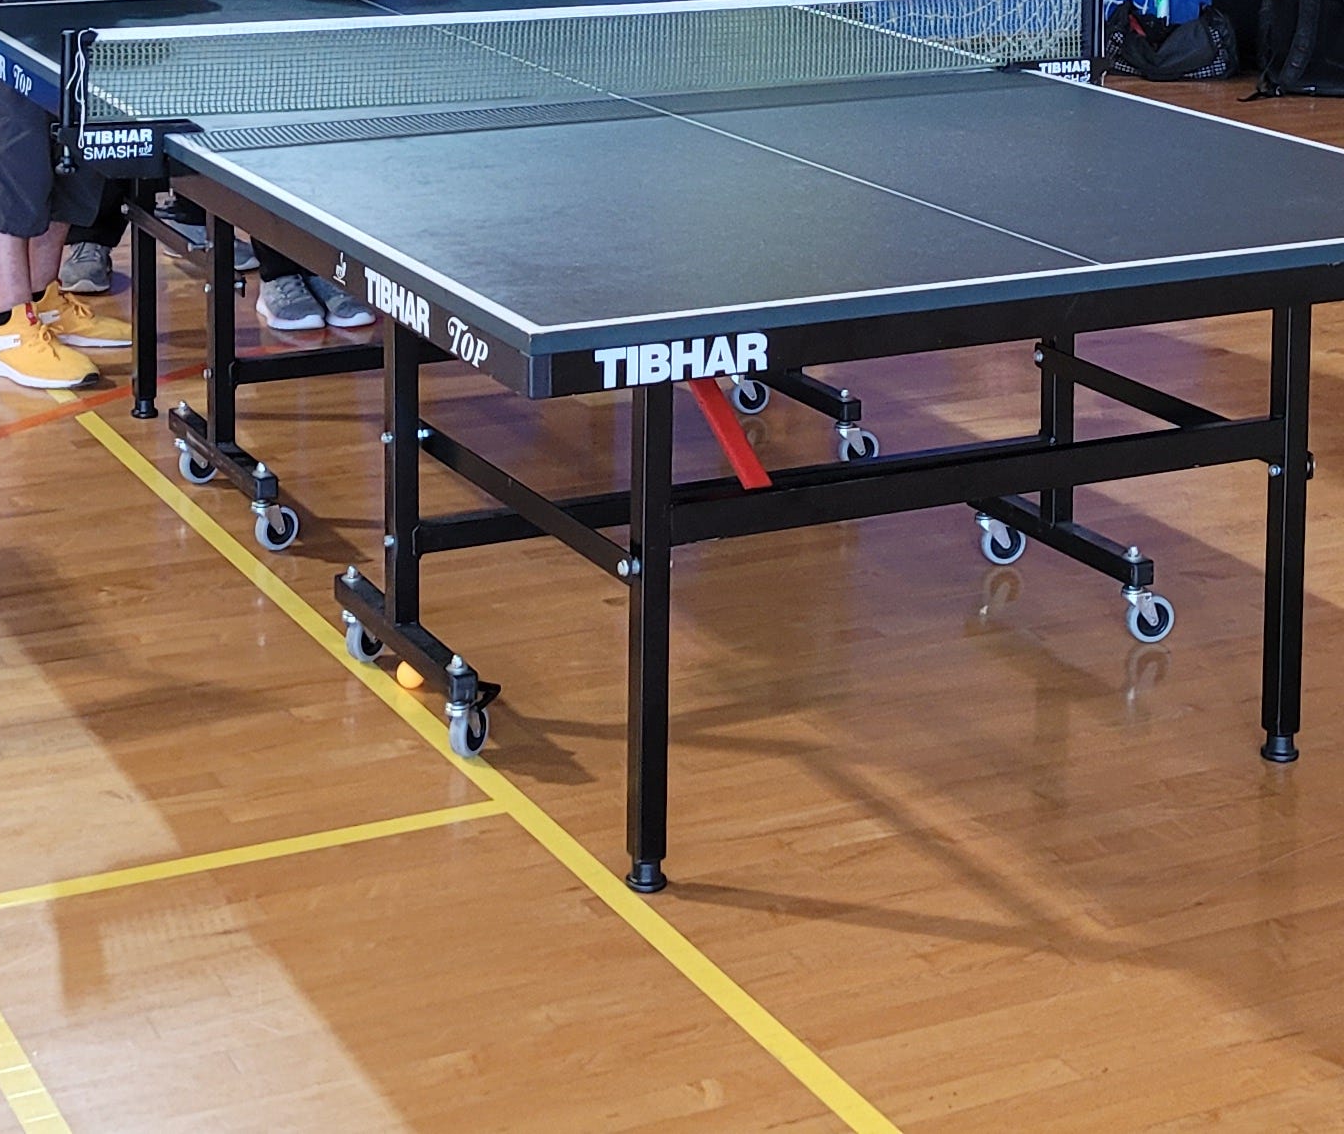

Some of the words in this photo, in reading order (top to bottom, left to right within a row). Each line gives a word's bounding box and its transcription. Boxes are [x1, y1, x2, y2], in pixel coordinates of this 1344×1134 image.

[1038, 60, 1091, 74] TIBHAR
[13, 64, 32, 97] TOP
[83, 128, 153, 145] TIBHAR
[83, 144, 138, 160] SMASH
[364, 266, 431, 339] TIBHAR
[447, 316, 489, 368] TOP
[594, 332, 768, 389] TIBHAR
